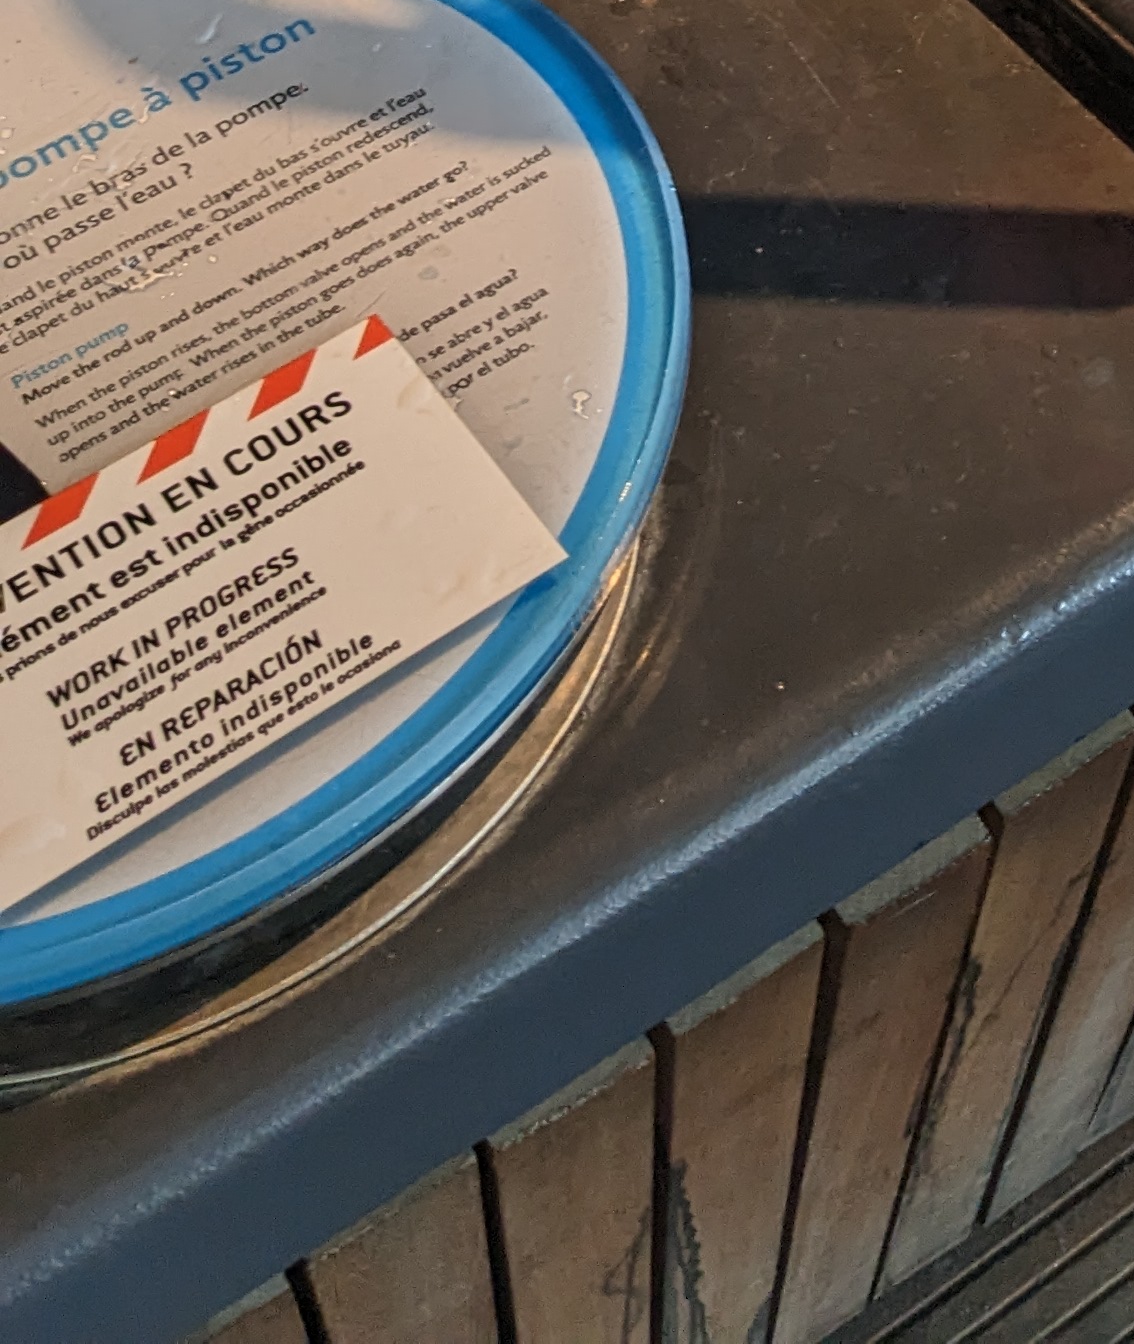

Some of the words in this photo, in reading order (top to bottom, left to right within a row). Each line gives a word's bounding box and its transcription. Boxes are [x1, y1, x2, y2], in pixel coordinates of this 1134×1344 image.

[140, 86, 172, 112] à
[178, 19, 316, 102] piston
[0, 285, 37, 314] and
[36, 279, 56, 293] le
[57, 249, 114, 285] piston
[177, 207, 197, 220] le
[252, 165, 277, 182] du
[275, 149, 309, 169] bas
[309, 118, 368, 153] s'ouvre
[369, 107, 388, 121] et
[385, 88, 427, 112] l'eau
[4, 244, 39, 269] où
[42, 207, 115, 254] passe
[114, 175, 178, 211] l'eau
[178, 162, 193, 179] ?
[11, 312, 68, 347] clapet
[69, 299, 95, 317] du
[94, 275, 139, 303] haut
[204, 232, 223, 247] et
[222, 211, 264, 236] l'eau
[265, 181, 322, 214] monte
[323, 159, 364, 184] dans
[361, 150, 381, 163] le
[13, 288, 77, 327] aspirée
[79, 265, 123, 291] dans
[208, 184, 272, 223] Quand
[269, 178, 290, 192] le
[290, 150, 345, 185] piston
[345, 102, 434, 153] redescend,
[60, 192, 88, 210] le
[87, 162, 148, 196] bras
[151, 144, 185, 166] de
[183, 130, 212, 148] la
[10, 352, 73, 389] Piston
[74, 323, 129, 359] pump
[21, 375, 71, 405] Move
[71, 359, 101, 378] the
[102, 338, 132, 362] rod
[133, 329, 157, 345] up
[159, 308, 190, 333] and
[191, 287, 243, 315] down.
[241, 255, 296, 286] Which
[296, 237, 329, 258] way
[331, 217, 369, 240] does
[368, 202, 396, 220] the
[396, 177, 440, 205] water
[442, 160, 468, 183] go?
[34, 398, 88, 428] When
[87, 383, 117, 402] the
[118, 355, 169, 389] piston
[211, 317, 240, 335] the
[238, 285, 299, 320] bottom
[299, 263, 340, 288] valve
[340, 238, 387, 266] opens
[388, 218, 417, 242] and
[416, 207, 443, 225] the
[443, 182, 485, 210] water
[485, 175, 502, 187] is
[502, 145, 551, 179] sucked
[46, 429, 70, 446] up
[70, 410, 107, 433] into
[107, 394, 137, 413] the
[187, 338, 240, 367] When
[239, 323, 268, 342] the
[268, 296, 318, 329] piston
[318, 275, 356, 302] goes
[355, 255, 393, 279] does
[438, 216, 465, 233] the
[465, 190, 509, 219] upper
[509, 170, 548, 194] valve
[420, 306, 458, 333] pasa
[458, 293, 474, 308] el
[474, 268, 518, 300] agua?
[427, 345, 446, 359] se
[446, 324, 482, 349] abre
[481, 317, 493, 332] y
[495, 305, 511, 321] el
[511, 288, 549, 312] agua
[441, 341, 492, 373] vuelve
[493, 335, 505, 345] a
[501, 311, 548, 338] bajar,
[59, 431, 108, 463] opens
[109, 410, 141, 435] and
[141, 397, 170, 416] the
[220, 350, 258, 374] rises
[256, 340, 276, 353] in
[275, 325, 304, 343] the
[303, 304, 346, 328] tube.
[446, 373, 473, 398] por
[476, 361, 492, 377] el
[491, 342, 535, 367] tubo.
[109, 549, 163, 588] est
[161, 439, 352, 556] indisponible
[160, 467, 219, 513] EN
[223, 391, 352, 476] COURS
[5, 643, 57, 681] prions
[57, 630, 78, 646] de
[78, 606, 119, 634] nous
[119, 568, 180, 609] excuser
[181, 547, 216, 577] pour
[218, 538, 236, 550] la
[236, 515, 274, 544] gêne
[274, 460, 365, 518] occasionnée
[46, 647, 130, 708] WORK
[131, 628, 160, 659] IN
[164, 547, 299, 639] PROGRESS
[60, 635, 208, 731] Unavailable
[215, 571, 315, 638] element
[67, 729, 91, 747] We
[93, 684, 165, 732] apologize
[170, 667, 191, 691] for
[193, 649, 223, 671] any
[222, 586, 327, 654] inconvenience
[94, 732, 214, 813] Elemento
[219, 634, 373, 736] indisponible
[119, 730, 156, 766] EN
[160, 629, 322, 742] REPARACIÓN
[86, 794, 153, 841] Disculpe
[154, 778, 180, 798] las
[181, 731, 255, 782] molestias
[256, 712, 284, 736] que
[286, 691, 319, 716] esto
[319, 681, 335, 695] le
[336, 639, 401, 685] ocasiona
